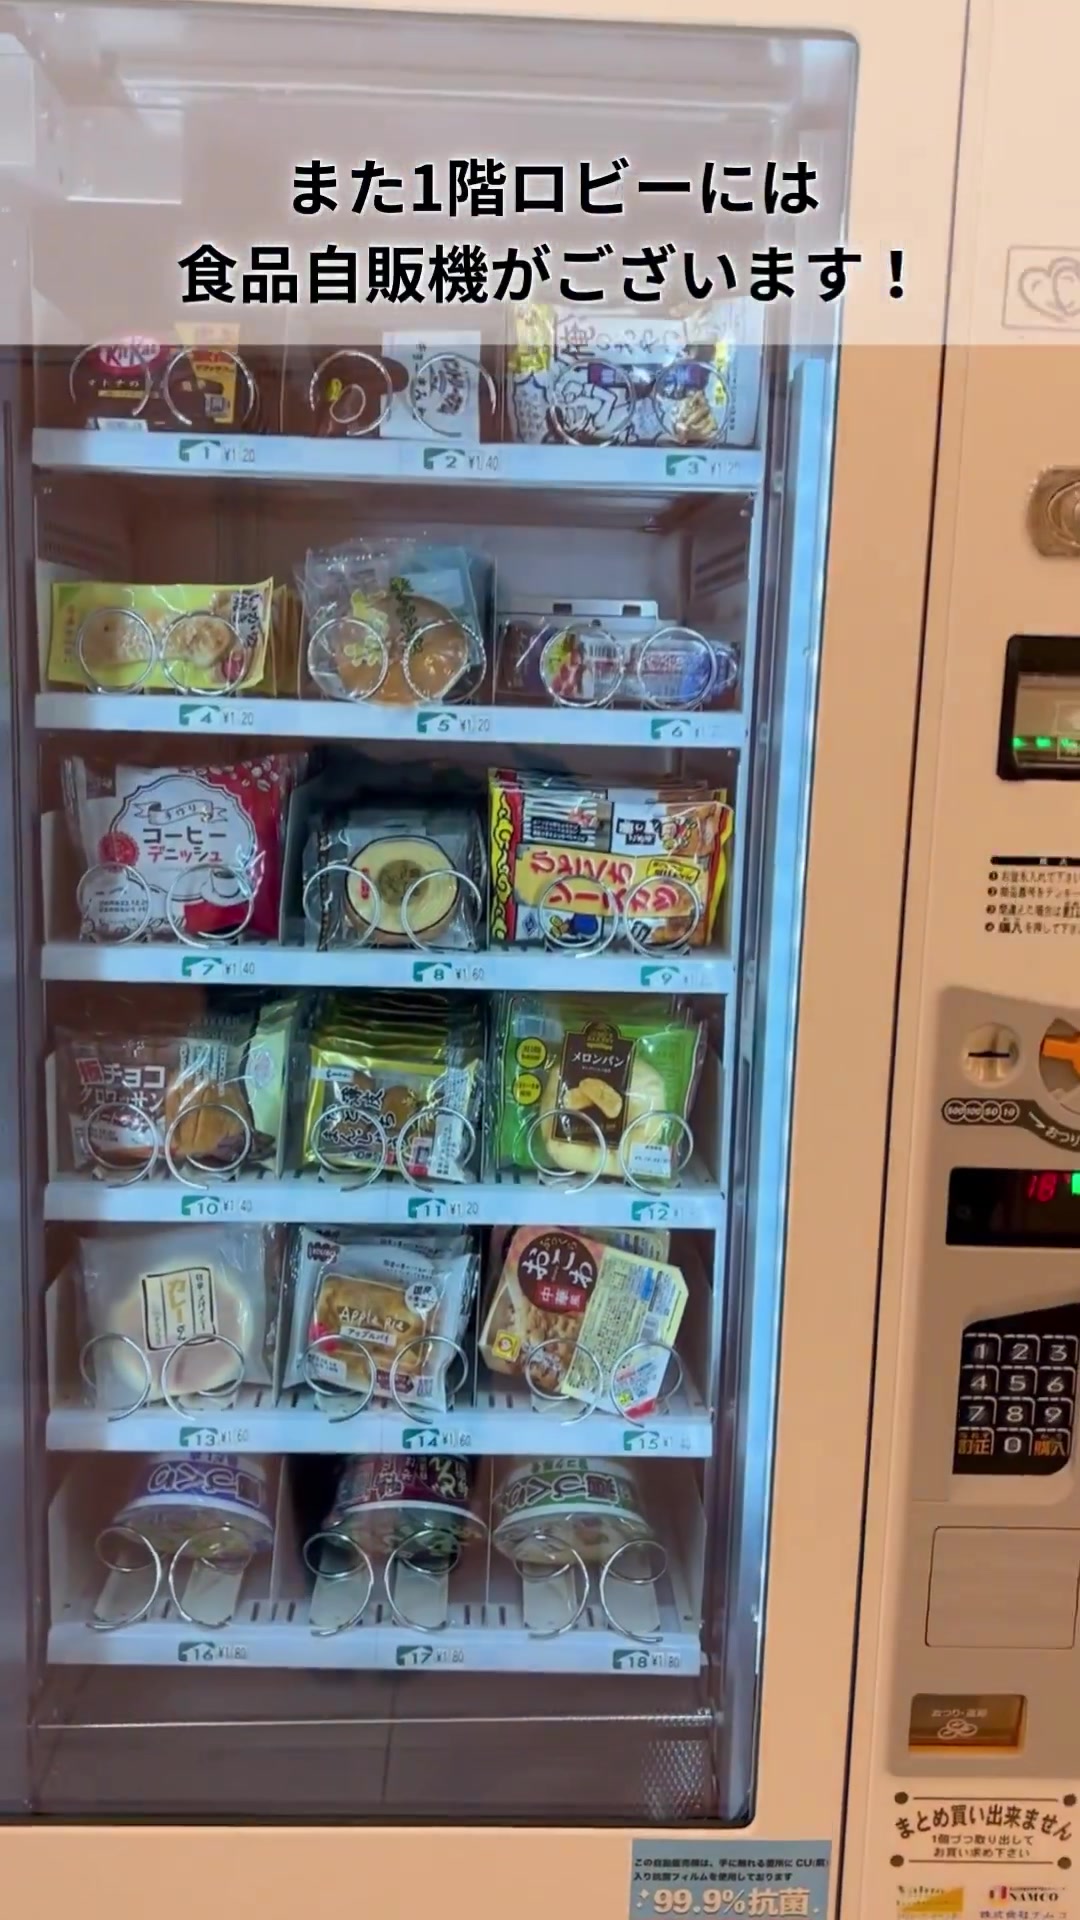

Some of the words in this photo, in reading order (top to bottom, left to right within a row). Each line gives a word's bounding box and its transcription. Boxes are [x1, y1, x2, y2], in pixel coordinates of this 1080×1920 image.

[143, 826, 227, 845] コーヒー
[148, 846, 223, 863] デニッシュ
[571, 1051, 625, 1067] メロンパン
[984, 1107, 998, 1116] 50
[1003, 1107, 1015, 1116] 10
[339, 1307, 379, 1326] Apple
[384, 1317, 405, 1332] pie
[347, 1327, 390, 1343] アップルパイ
[975, 1343, 985, 1360] 1
[1012, 1343, 1029, 1360] 2
[1050, 1344, 1067, 1361] 3
[971, 1375, 988, 1390] 4
[1009, 1375, 1026, 1391] 5
[1047, 1376, 1064, 1392] 6
[968, 1406, 985, 1421] 7
[1006, 1406, 1023, 1422] 8
[1044, 1407, 1062, 1422] 9
[1004, 1436, 1022, 1453] 0
[895, 1803, 1073, 1842] まとめ買い出来ません
[932, 1833, 1034, 1846] 1個づつ取り出して
[934, 1847, 1031, 1859] お買い求め下さい
[633, 1872, 793, 1882] 入り抗菌フィルムを使用しております
[653, 1887, 811, 1917] 99.9%抗菌
